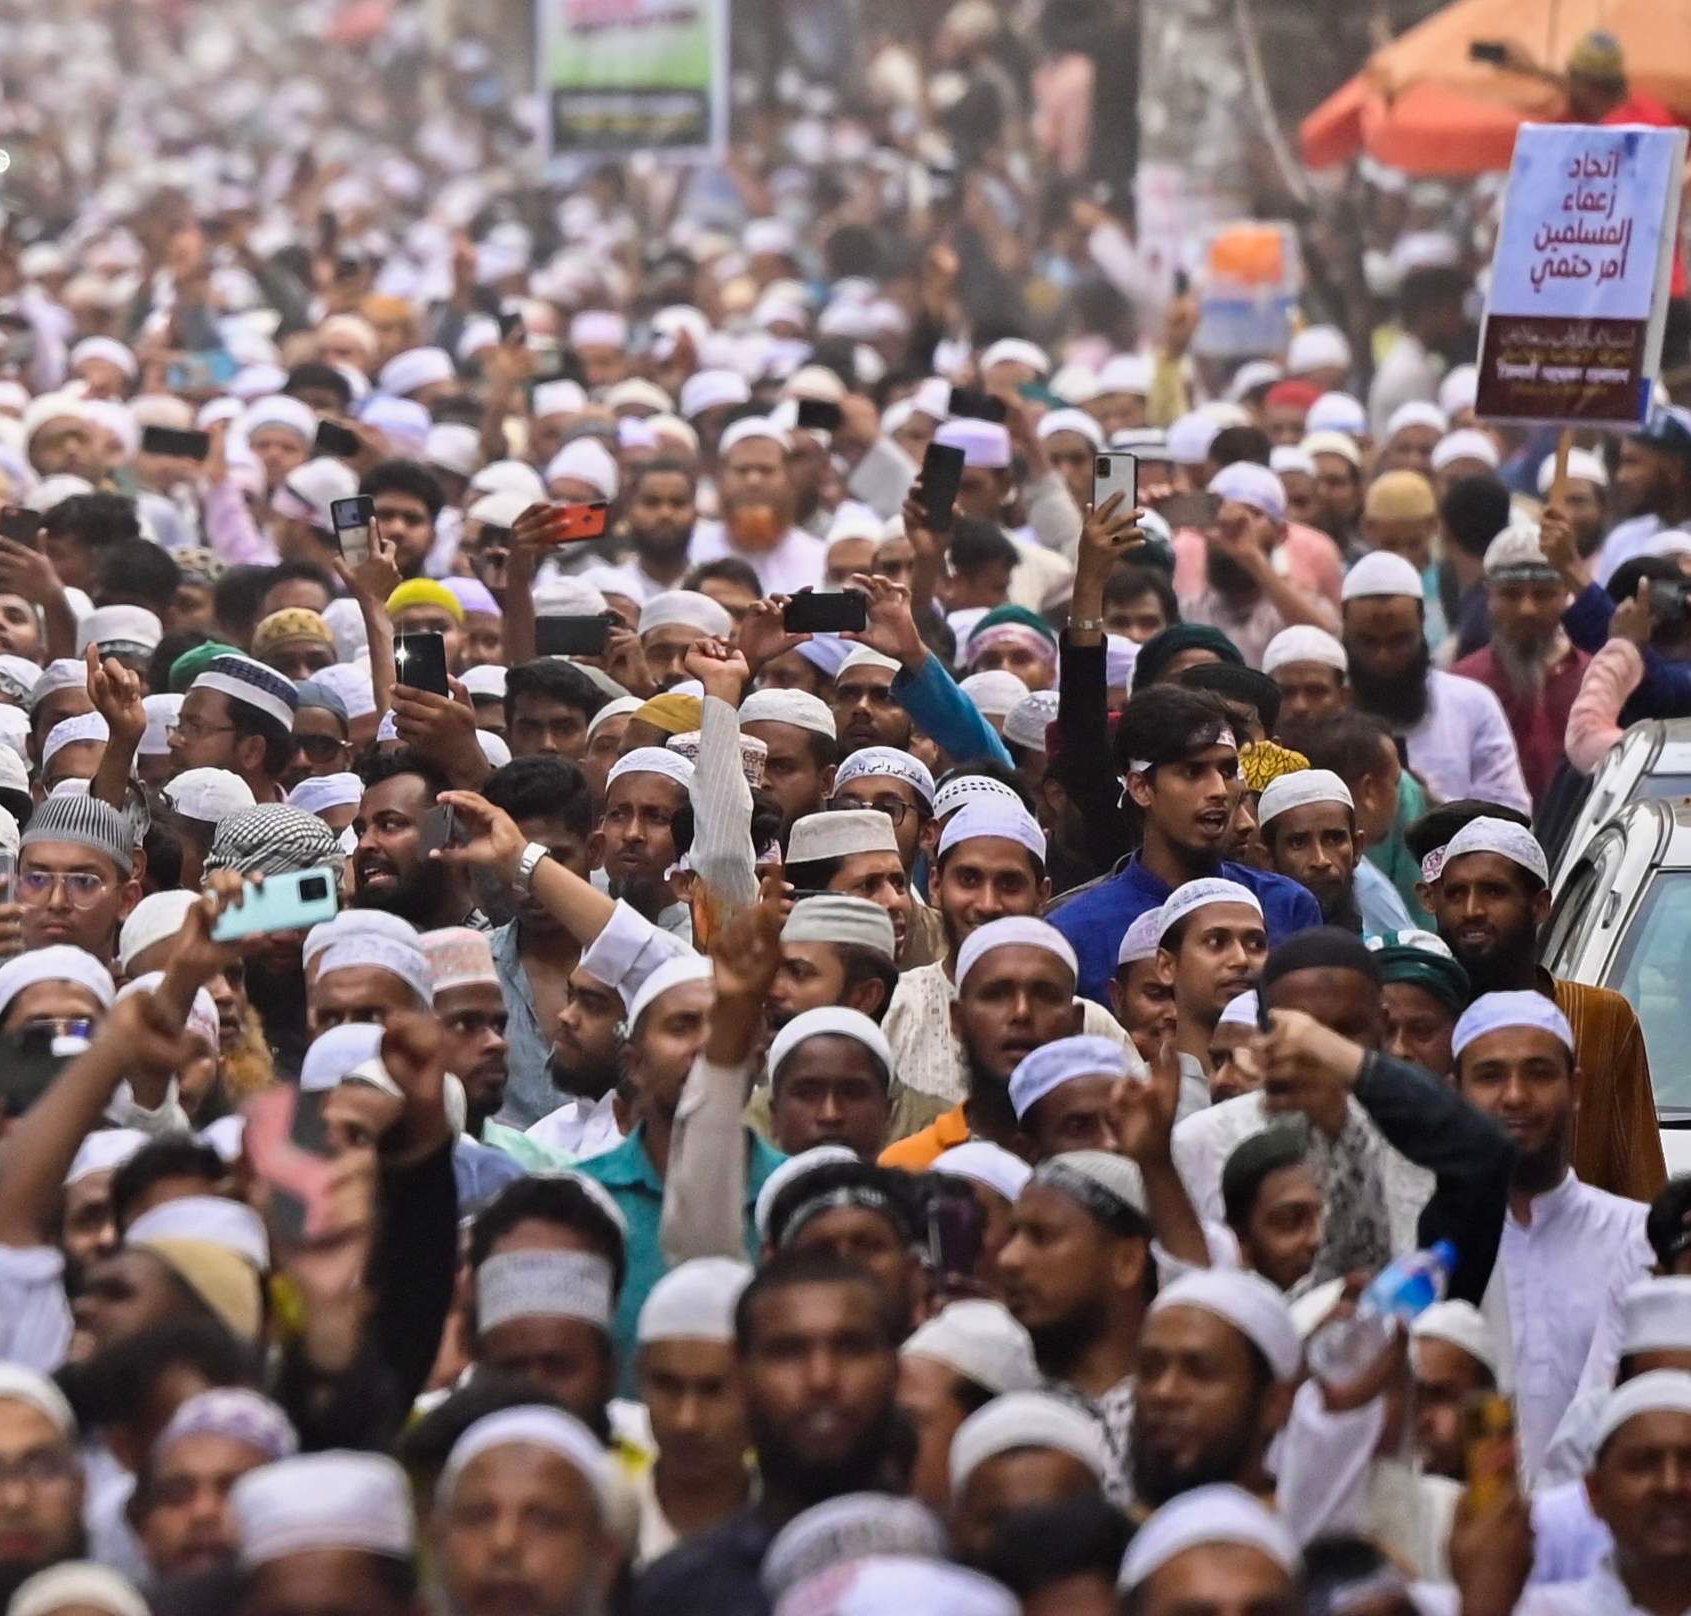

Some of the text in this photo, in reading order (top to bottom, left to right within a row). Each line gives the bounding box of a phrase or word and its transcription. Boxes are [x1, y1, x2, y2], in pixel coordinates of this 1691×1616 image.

[1562, 184, 1617, 220] زعماء
[1534, 218, 1633, 252] المسلمين
[1530, 254, 1592, 293] حتمي
